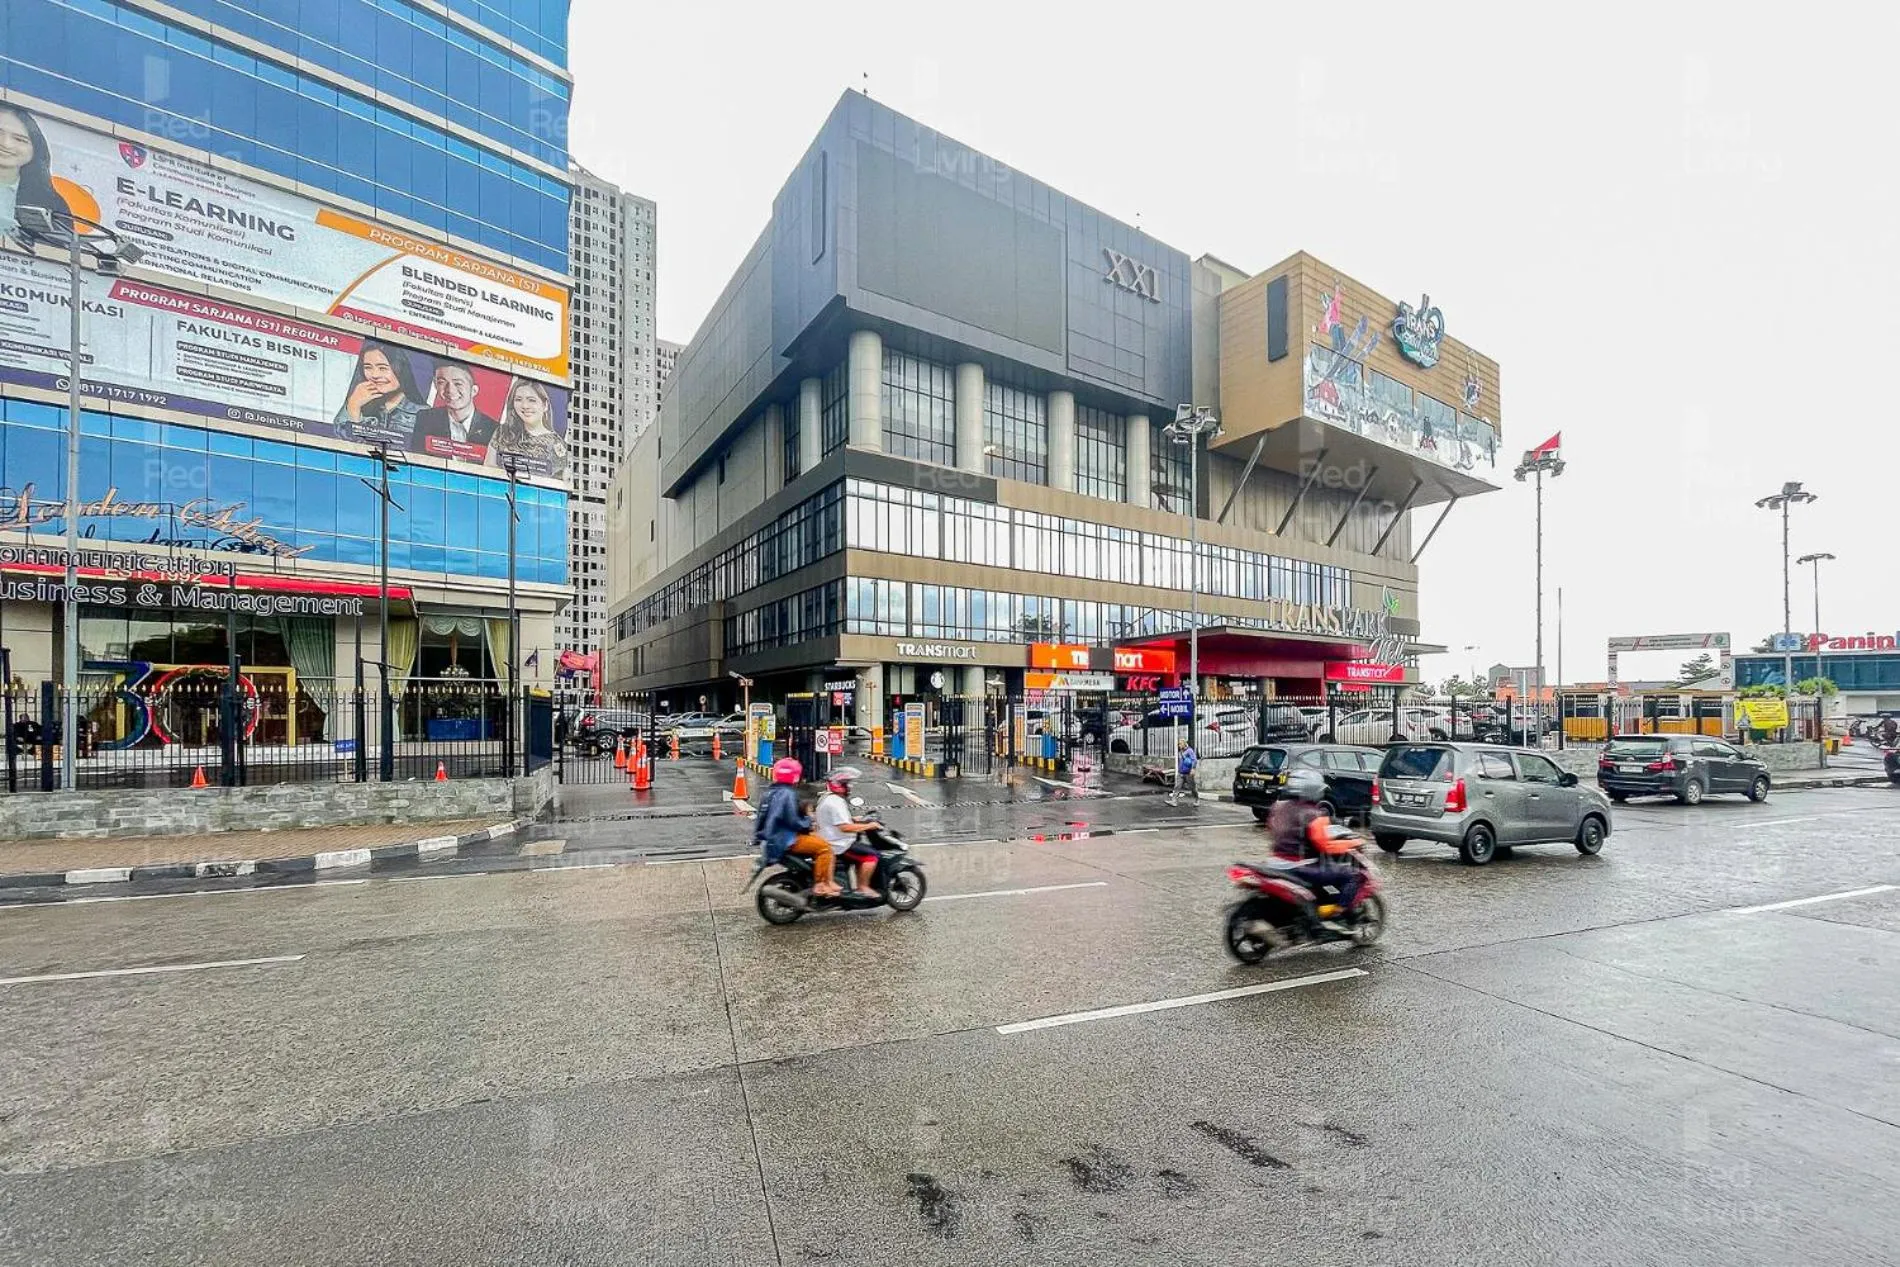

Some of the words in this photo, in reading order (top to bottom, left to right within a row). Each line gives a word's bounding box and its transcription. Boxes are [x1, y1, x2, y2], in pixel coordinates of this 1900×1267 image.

[116, 197, 173, 219] (Fakultas
[174, 208, 246, 240] Komunikasi)
[117, 176, 296, 242] E-LEARNING
[118, 209, 173, 229] Program
[174, 221, 206, 239] Studi
[207, 230, 273, 256] Komunikasi
[369, 228, 450, 265] PROGRAM
[452, 256, 516, 286] SARJANA
[1103, 247, 1161, 303] XXI
[0, 283, 125, 319] KOMUNKASI
[259, 269, 334, 296] COMMUNICATION
[401, 265, 479, 299] BLENDED
[480, 285, 555, 322] LEARNING
[119, 287, 190, 312] PROGRAM
[192, 303, 253, 326] SARJANA
[255, 317, 281, 334] (S1)
[282, 325, 339, 347] REGULAR
[176, 319, 262, 349] FAKULTAS
[266, 340, 319, 362] BISNIS
[106, 386, 137, 400] 1717
[138, 391, 167, 406] 1992
[136, 583, 163, 607] &
[171, 584, 363, 617] Management
[1262, 597, 1341, 634] TRANS
[1342, 606, 1390, 640] PARK
[896, 642, 977, 659] TRANSmart
[1807, 632, 1897, 653] Panin
[824, 679, 856, 691] STARBUCKS
[1125, 675, 1159, 692] KFC
[1170, 704, 1189, 713] MOBIL
